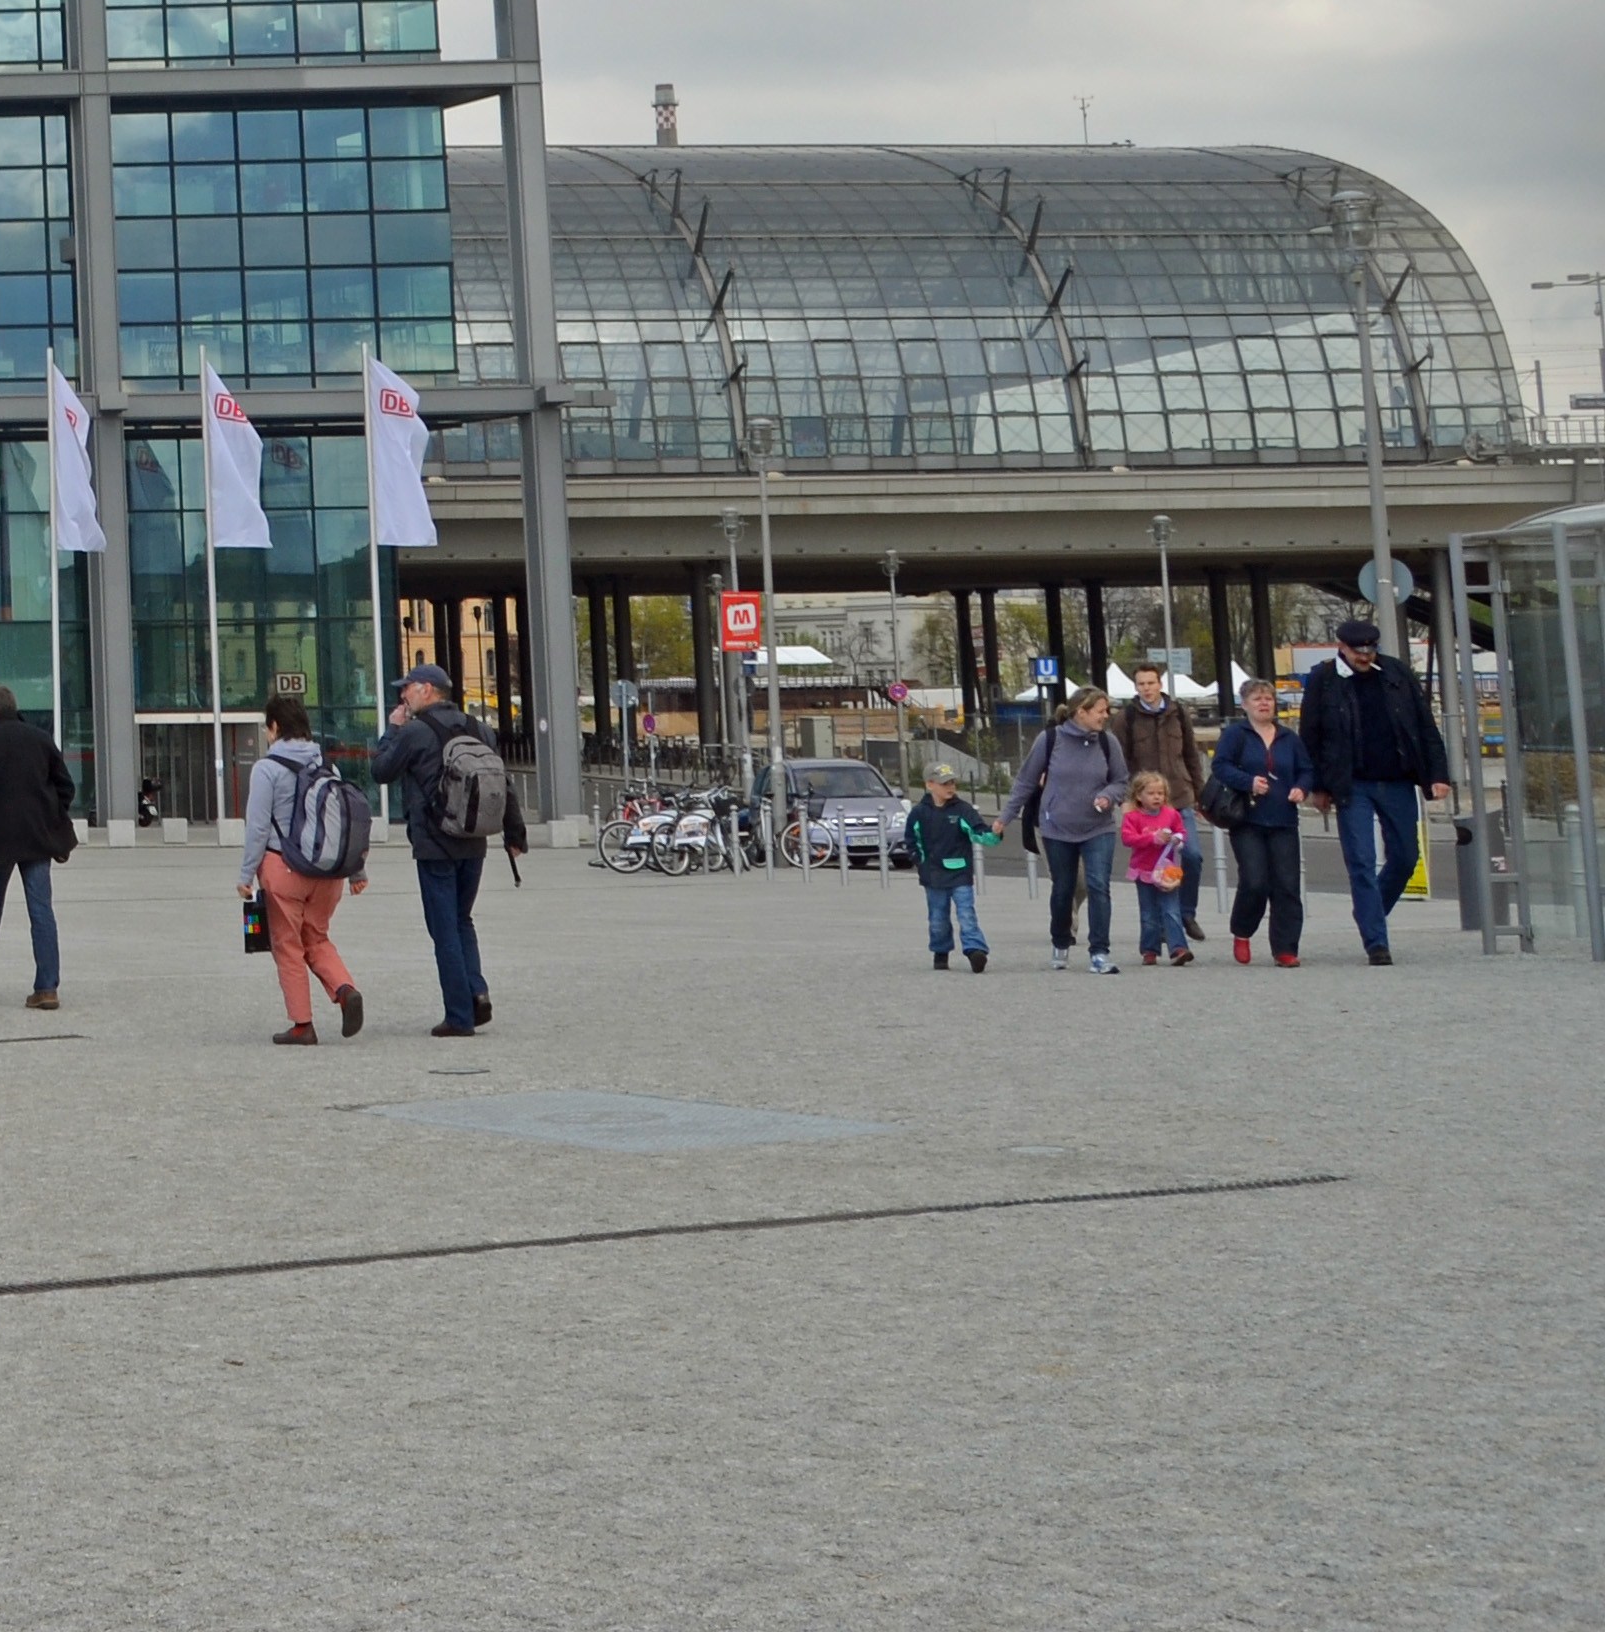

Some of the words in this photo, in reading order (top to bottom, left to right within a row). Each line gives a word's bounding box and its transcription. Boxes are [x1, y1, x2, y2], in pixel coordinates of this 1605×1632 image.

[734, 610, 751, 625] M
[1040, 659, 1053, 675] U
[280, 676, 302, 691] DB
